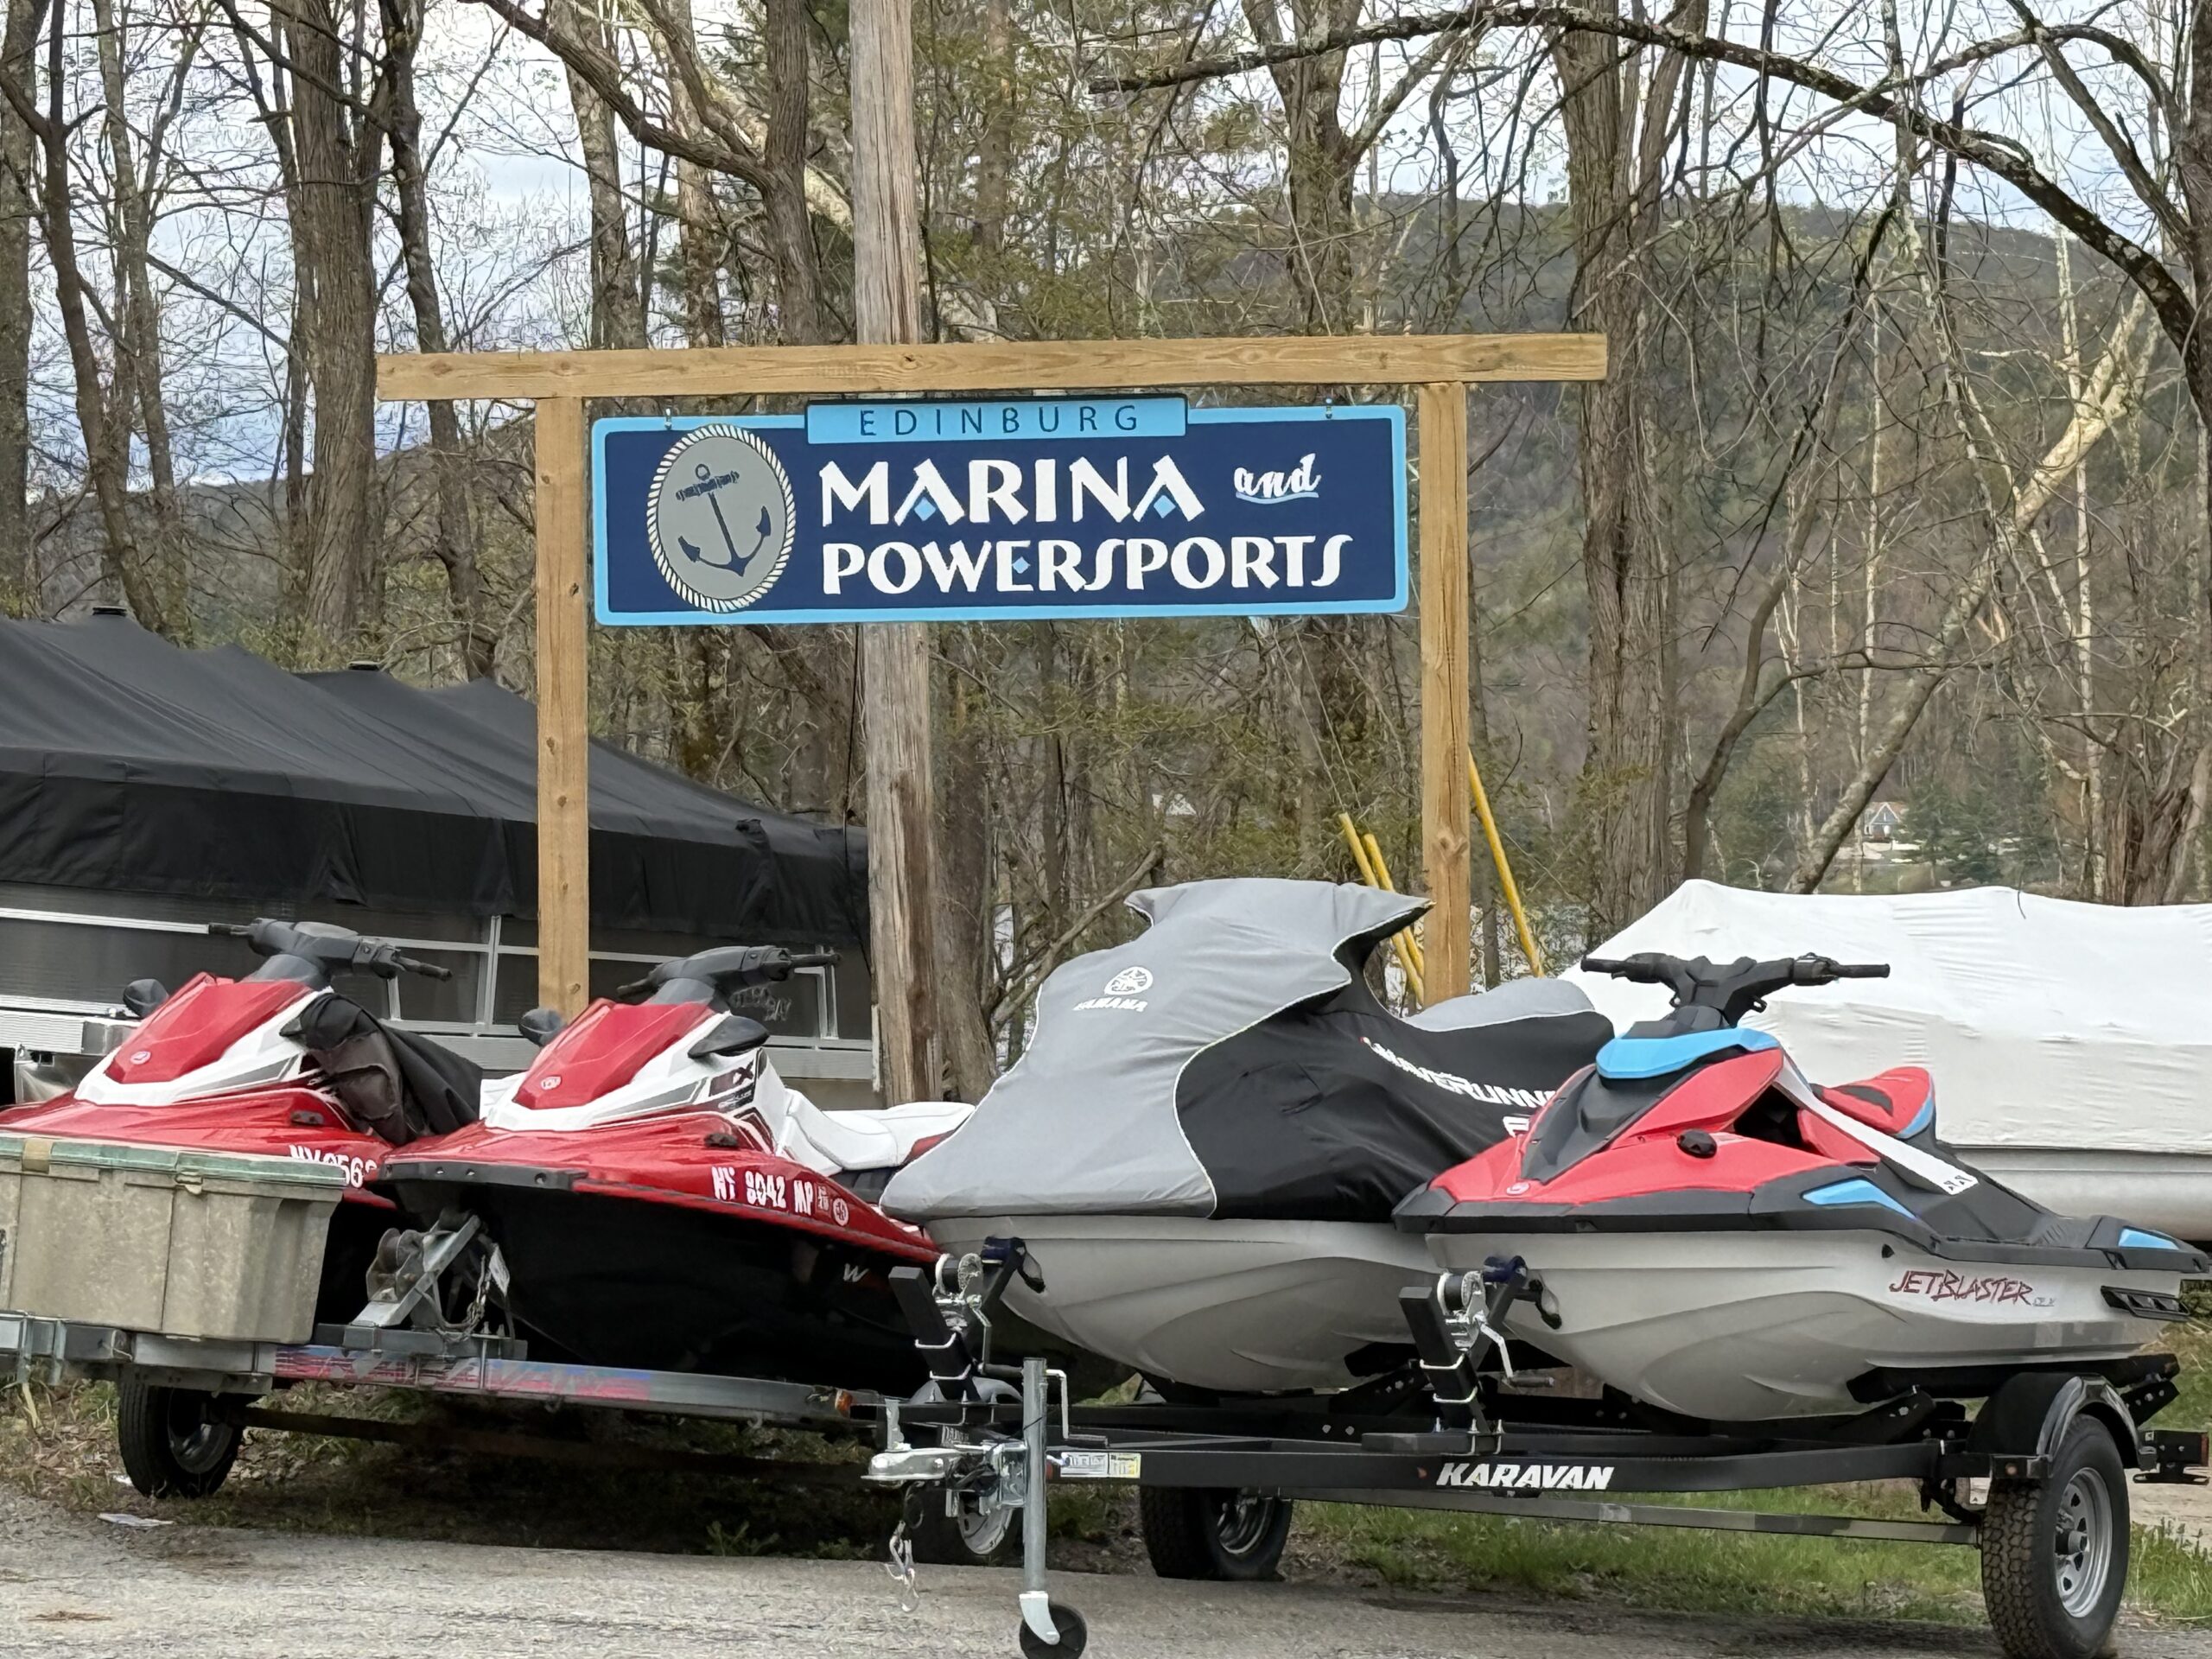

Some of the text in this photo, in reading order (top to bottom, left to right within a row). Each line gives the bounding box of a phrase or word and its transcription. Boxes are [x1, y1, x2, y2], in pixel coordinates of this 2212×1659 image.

[861, 405, 1138, 436] EDINBURG
[819, 453, 1321, 526] MARINA and
[823, 534, 1354, 594] POWERSPORTS
[1435, 1462, 1615, 1490] KARAVAN
